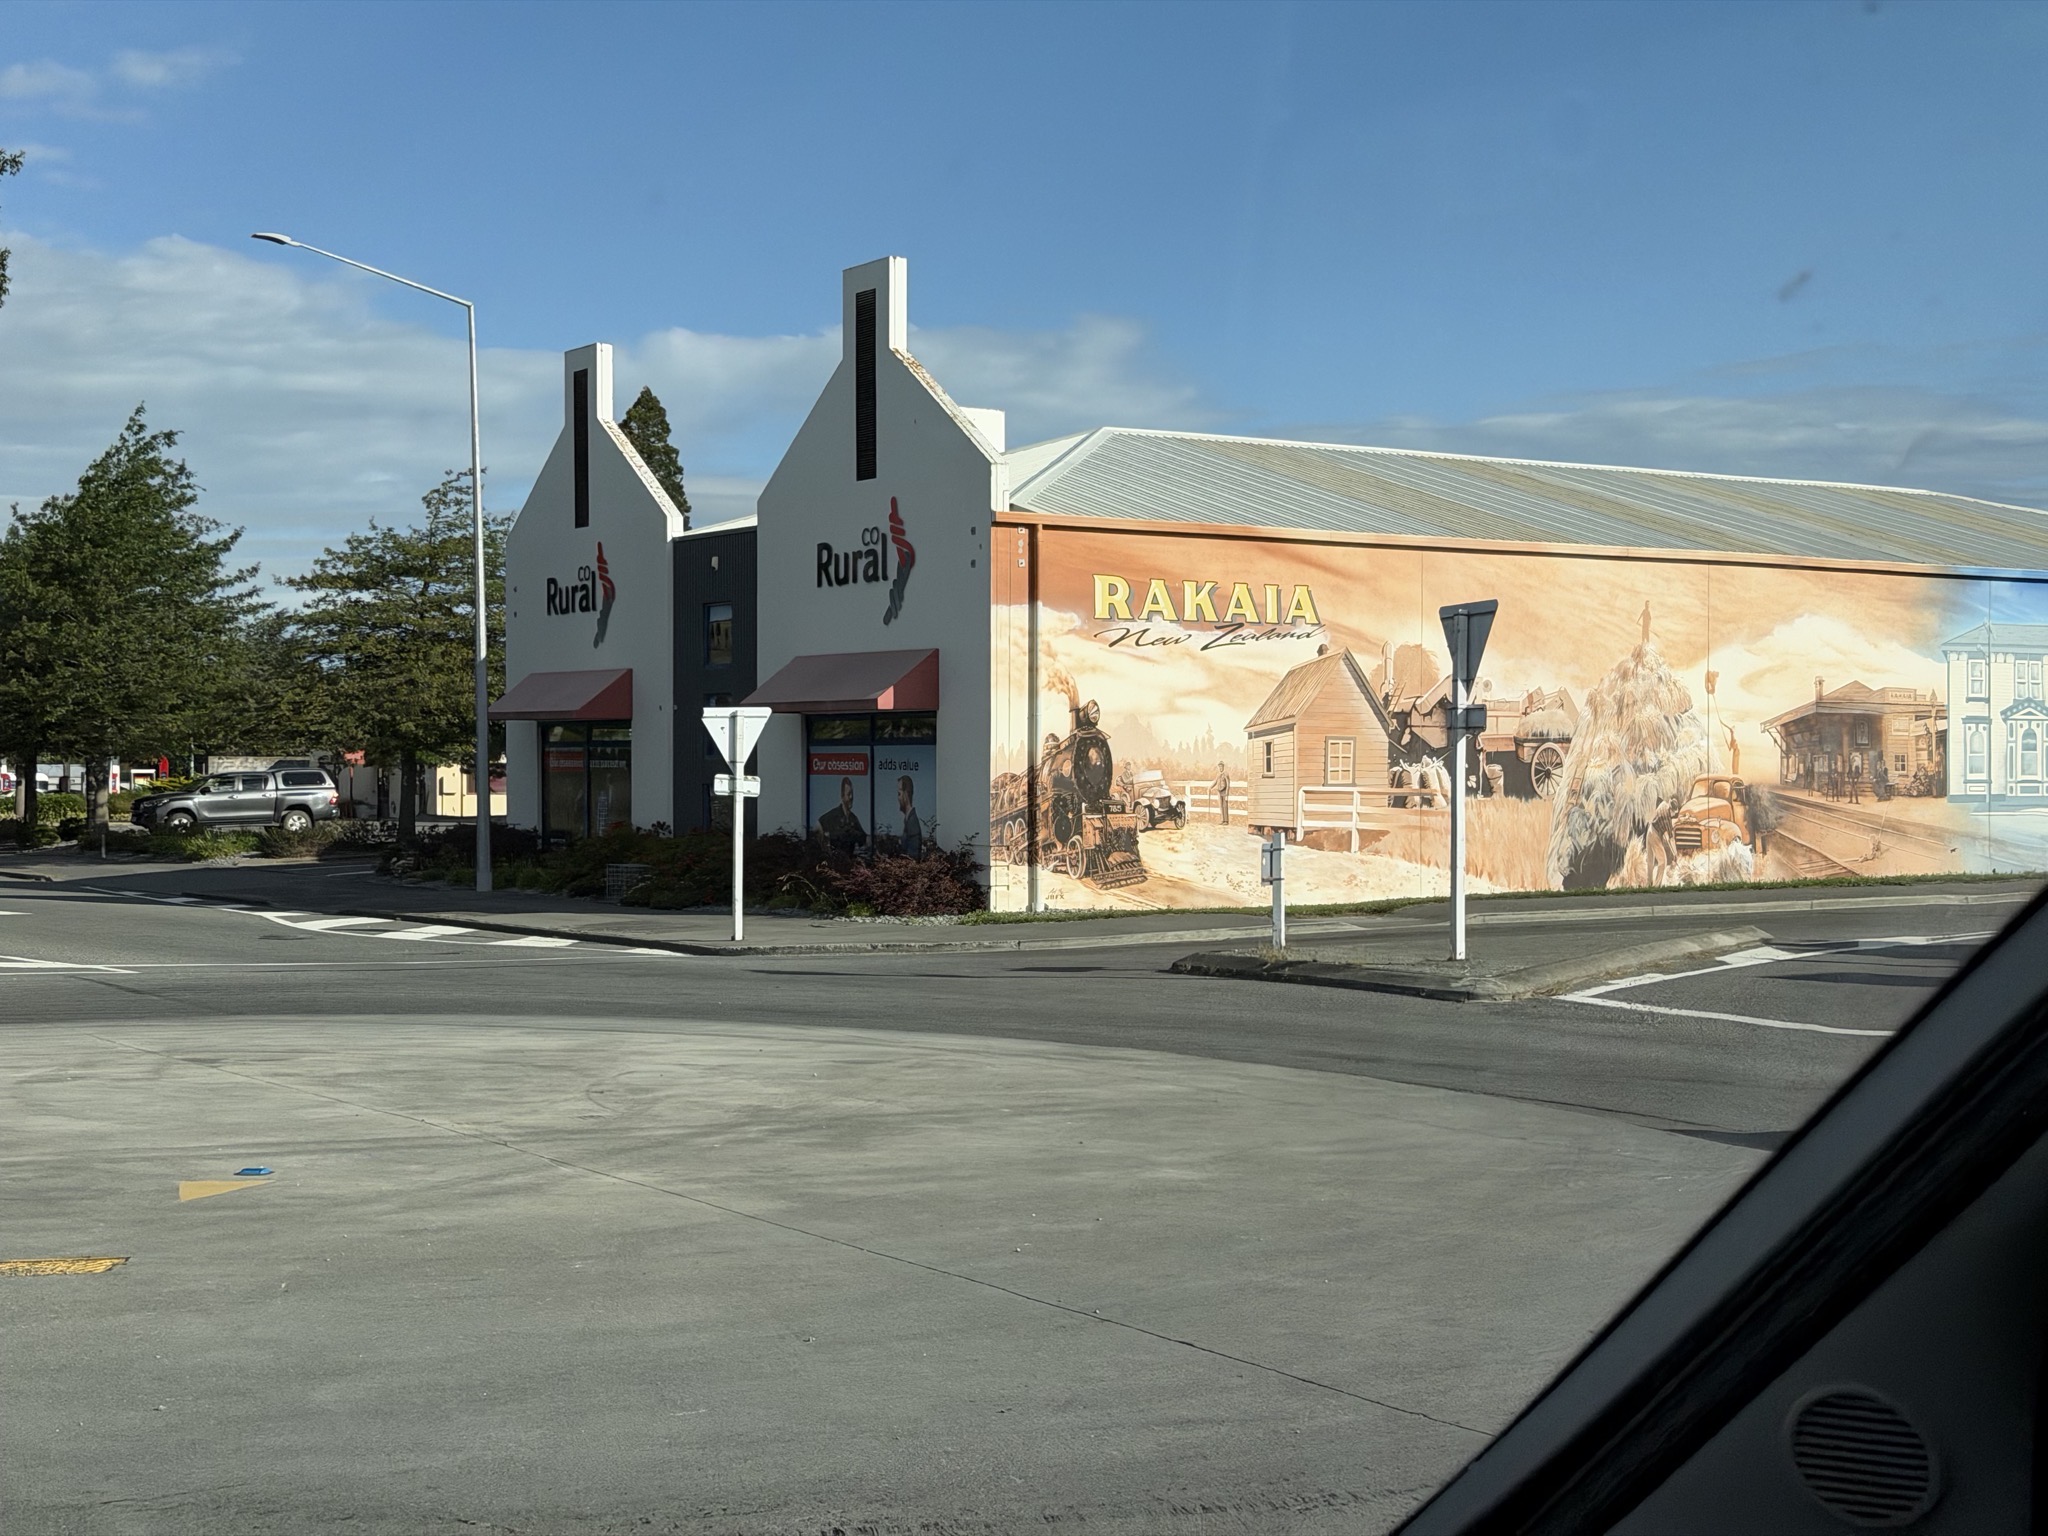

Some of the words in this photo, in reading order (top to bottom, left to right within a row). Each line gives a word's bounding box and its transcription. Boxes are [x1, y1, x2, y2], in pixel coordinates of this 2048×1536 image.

[817, 533, 889, 588] Rural
[546, 570, 597, 616] Rural
[1092, 573, 1322, 626] RAKAIA
[1093, 627, 1192, 649] New
[1200, 622, 1326, 652] Zealand
[827, 758, 865, 771] obsession
[878, 757, 897, 771] adds
[898, 757, 919, 771] value
